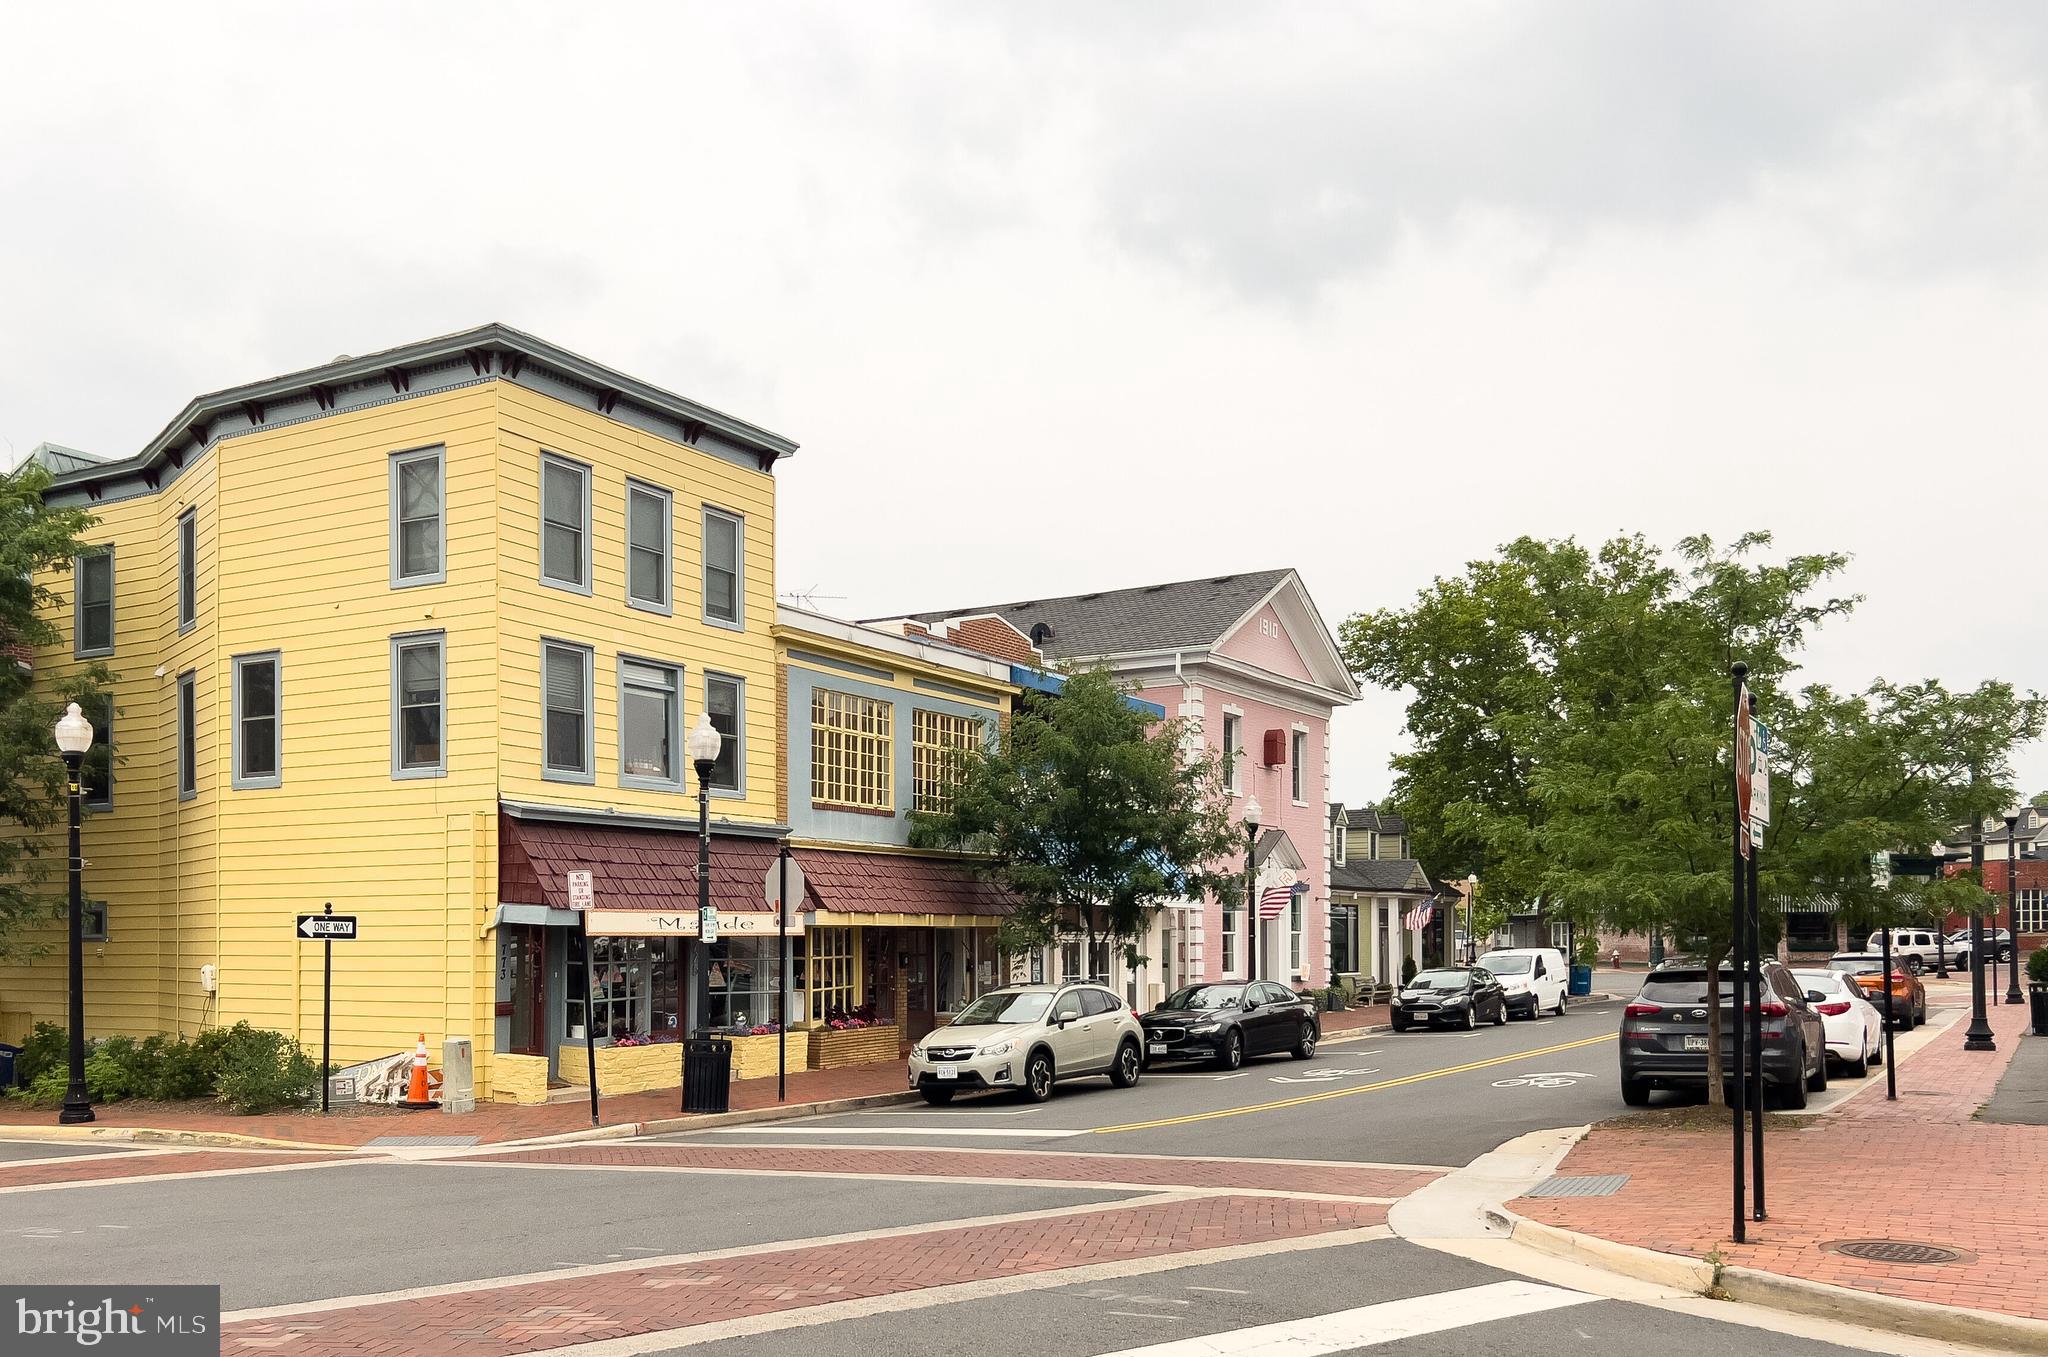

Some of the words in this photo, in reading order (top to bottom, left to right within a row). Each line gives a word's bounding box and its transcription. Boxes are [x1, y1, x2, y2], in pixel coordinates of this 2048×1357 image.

[1259, 617, 1279, 639] 1910
[575, 873, 585, 881] NO
[313, 922, 331, 932] ONE
[332, 922, 351, 932] WAY
